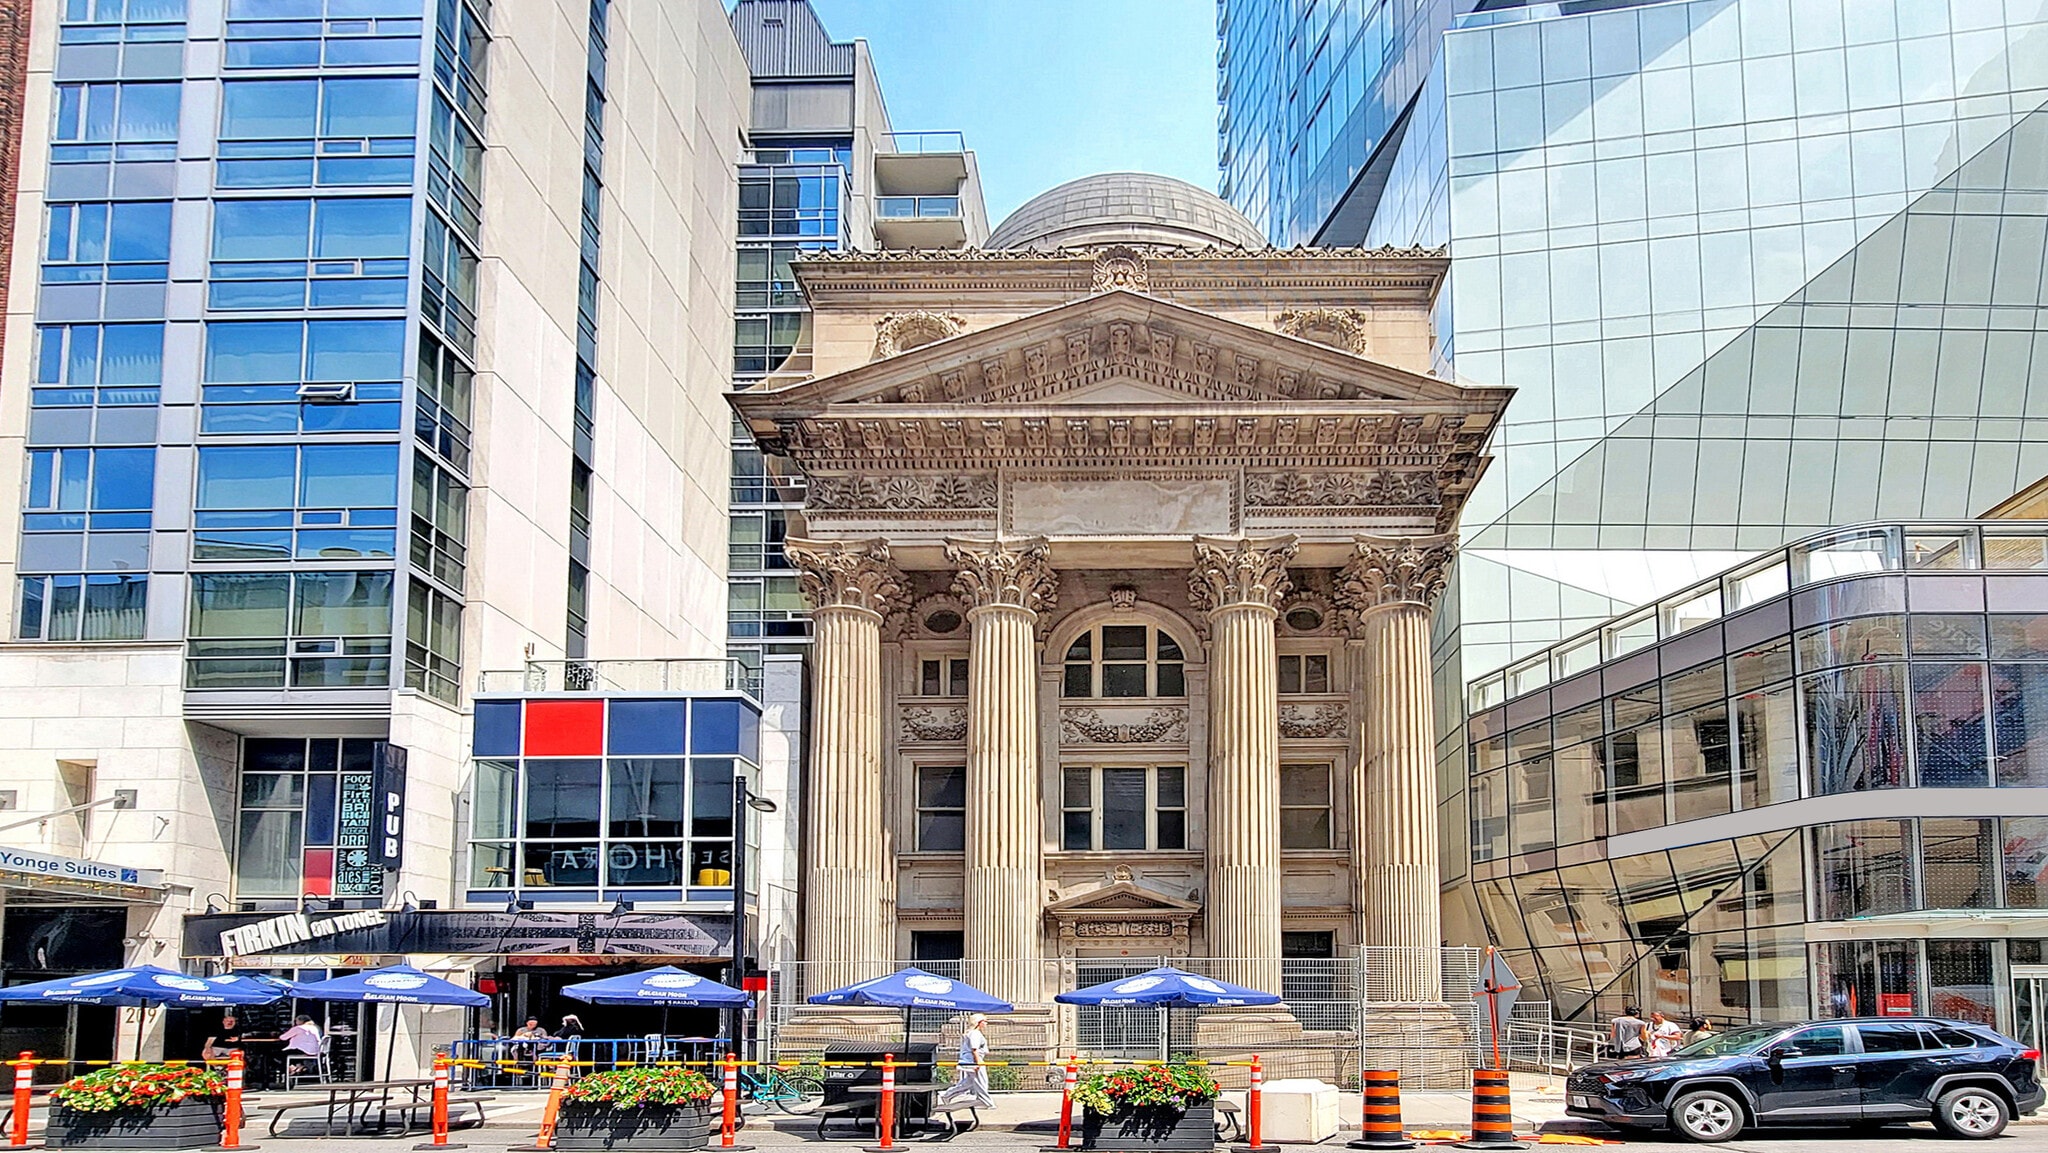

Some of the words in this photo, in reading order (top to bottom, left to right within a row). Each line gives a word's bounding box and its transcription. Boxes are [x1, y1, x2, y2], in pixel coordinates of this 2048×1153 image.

[384, 792, 400, 858] PUB
[1, 852, 59, 873] Yonge
[65, 861, 117, 879] Suites
[338, 871, 361, 883] ales
[220, 912, 312, 957] FIRKIN
[310, 919, 336, 938] ON
[333, 909, 387, 932] YONGE
